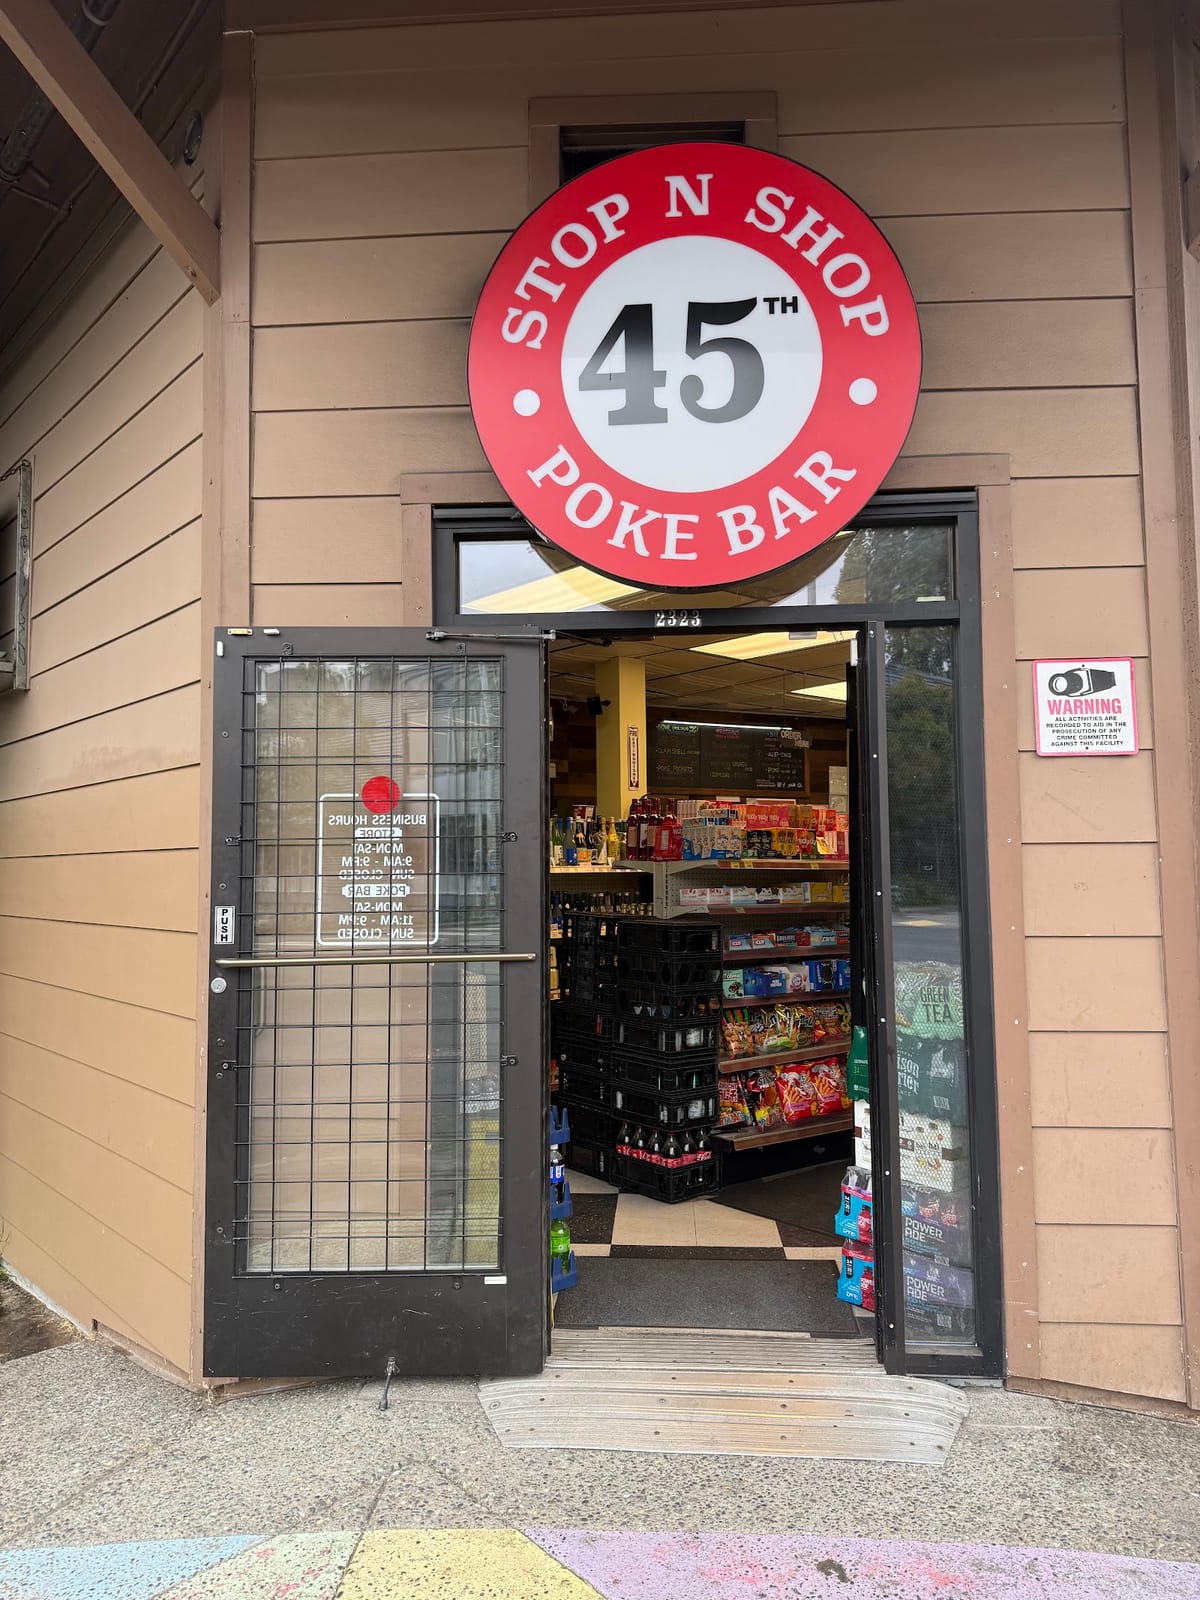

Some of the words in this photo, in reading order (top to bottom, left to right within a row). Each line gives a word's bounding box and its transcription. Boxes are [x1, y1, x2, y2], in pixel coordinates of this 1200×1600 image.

[502, 193, 631, 350] STOP
[664, 173, 714, 218] N
[743, 185, 890, 338] SHOP
[525, 444, 700, 561] POKE
[716, 449, 857, 557] BAR
[656, 610, 701, 627] 2323
[1047, 698, 1122, 715] WARNING
[220, 909, 229, 942] PUSH
[920, 985, 950, 1003] GREEN
[923, 1003, 952, 1023] TEA
[904, 1227, 926, 1242] ADE
[905, 1217, 943, 1239] POWER
[906, 1276, 945, 1298] POWER
[906, 1286, 928, 1302] ADE
